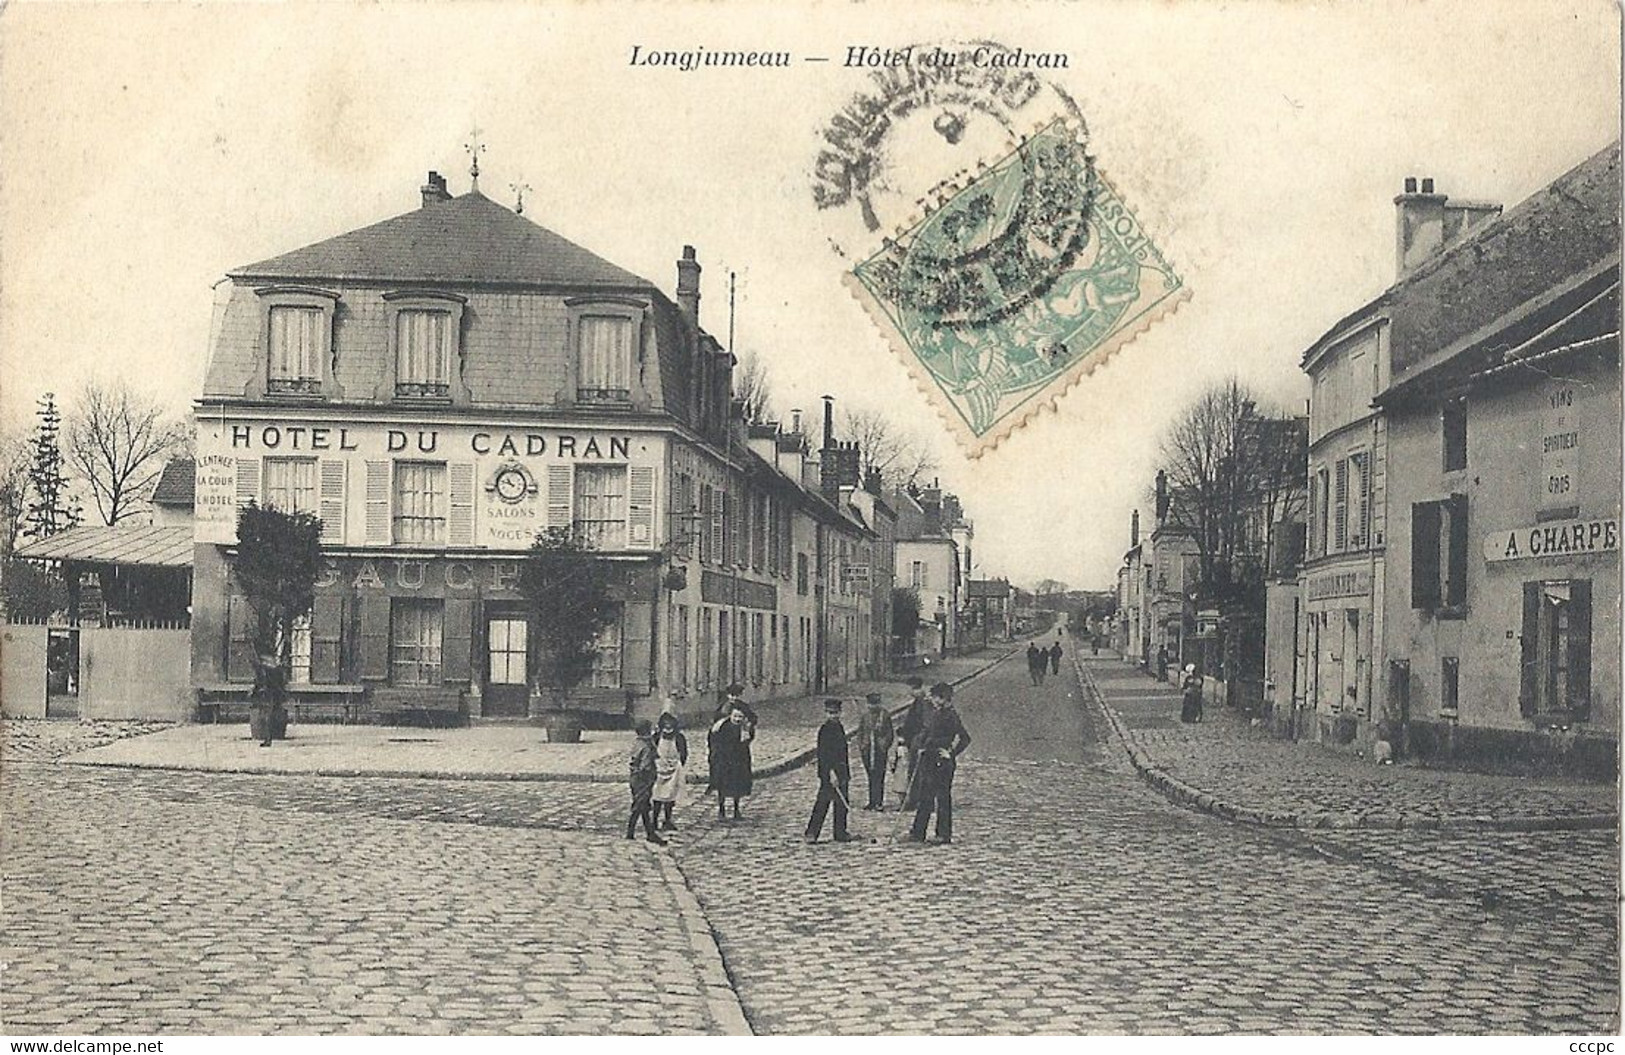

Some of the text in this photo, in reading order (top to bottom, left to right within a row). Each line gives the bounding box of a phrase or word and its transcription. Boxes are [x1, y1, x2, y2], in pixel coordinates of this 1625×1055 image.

[387, 429, 438, 453] DU
[471, 432, 632, 460] CADRAN
[208, 476, 234, 486] COUR
[486, 507, 536, 519] SALONS
